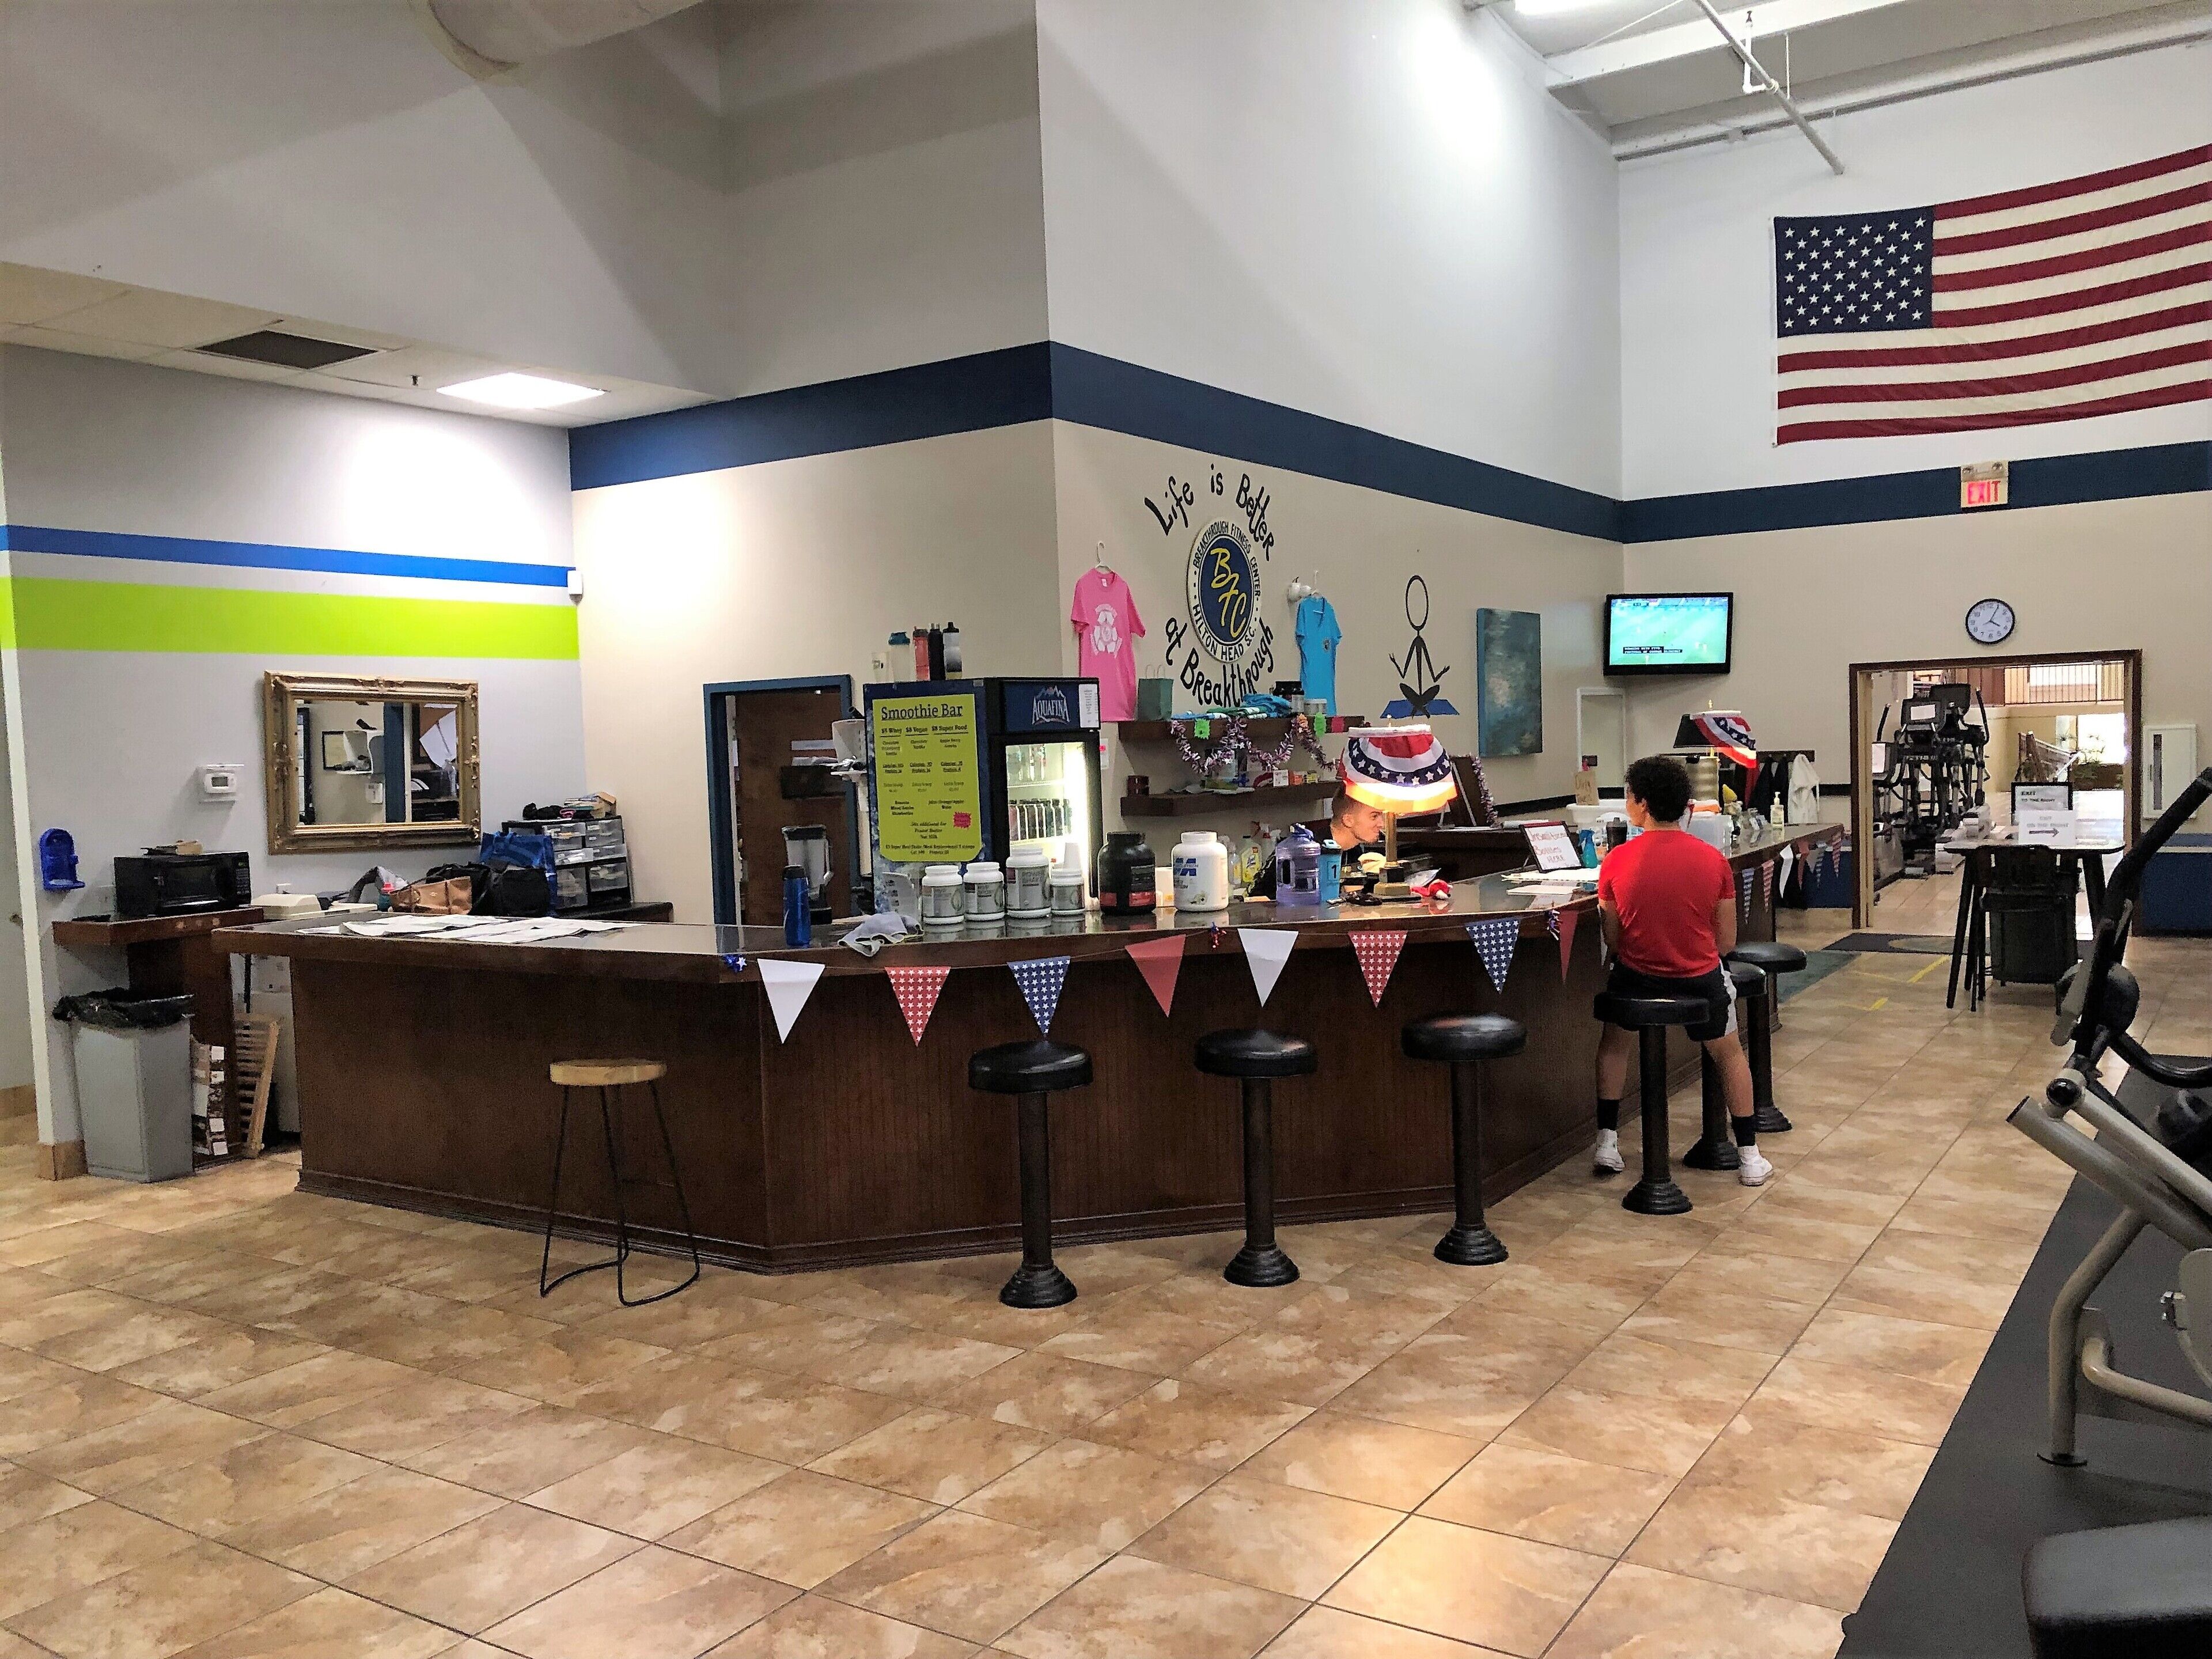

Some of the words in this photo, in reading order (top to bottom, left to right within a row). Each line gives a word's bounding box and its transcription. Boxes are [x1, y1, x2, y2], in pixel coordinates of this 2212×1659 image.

[1144, 475, 1194, 537] Life
[1210, 463, 1224, 496] is
[1967, 479, 2002, 505] EXIT
[1192, 520, 1229, 569] BREAKTHROUGH
[1230, 523, 1252, 555] FITNESS
[1250, 556, 1261, 597] CENTER
[1165, 617, 1188, 666] at
[1192, 603, 1218, 656] HILTON
[1221, 643, 1244, 661] HEAD
[881, 703, 939, 721] Smoothie
[941, 703, 963, 718] Bar
[1031, 695, 1070, 725] AQUAFINA
